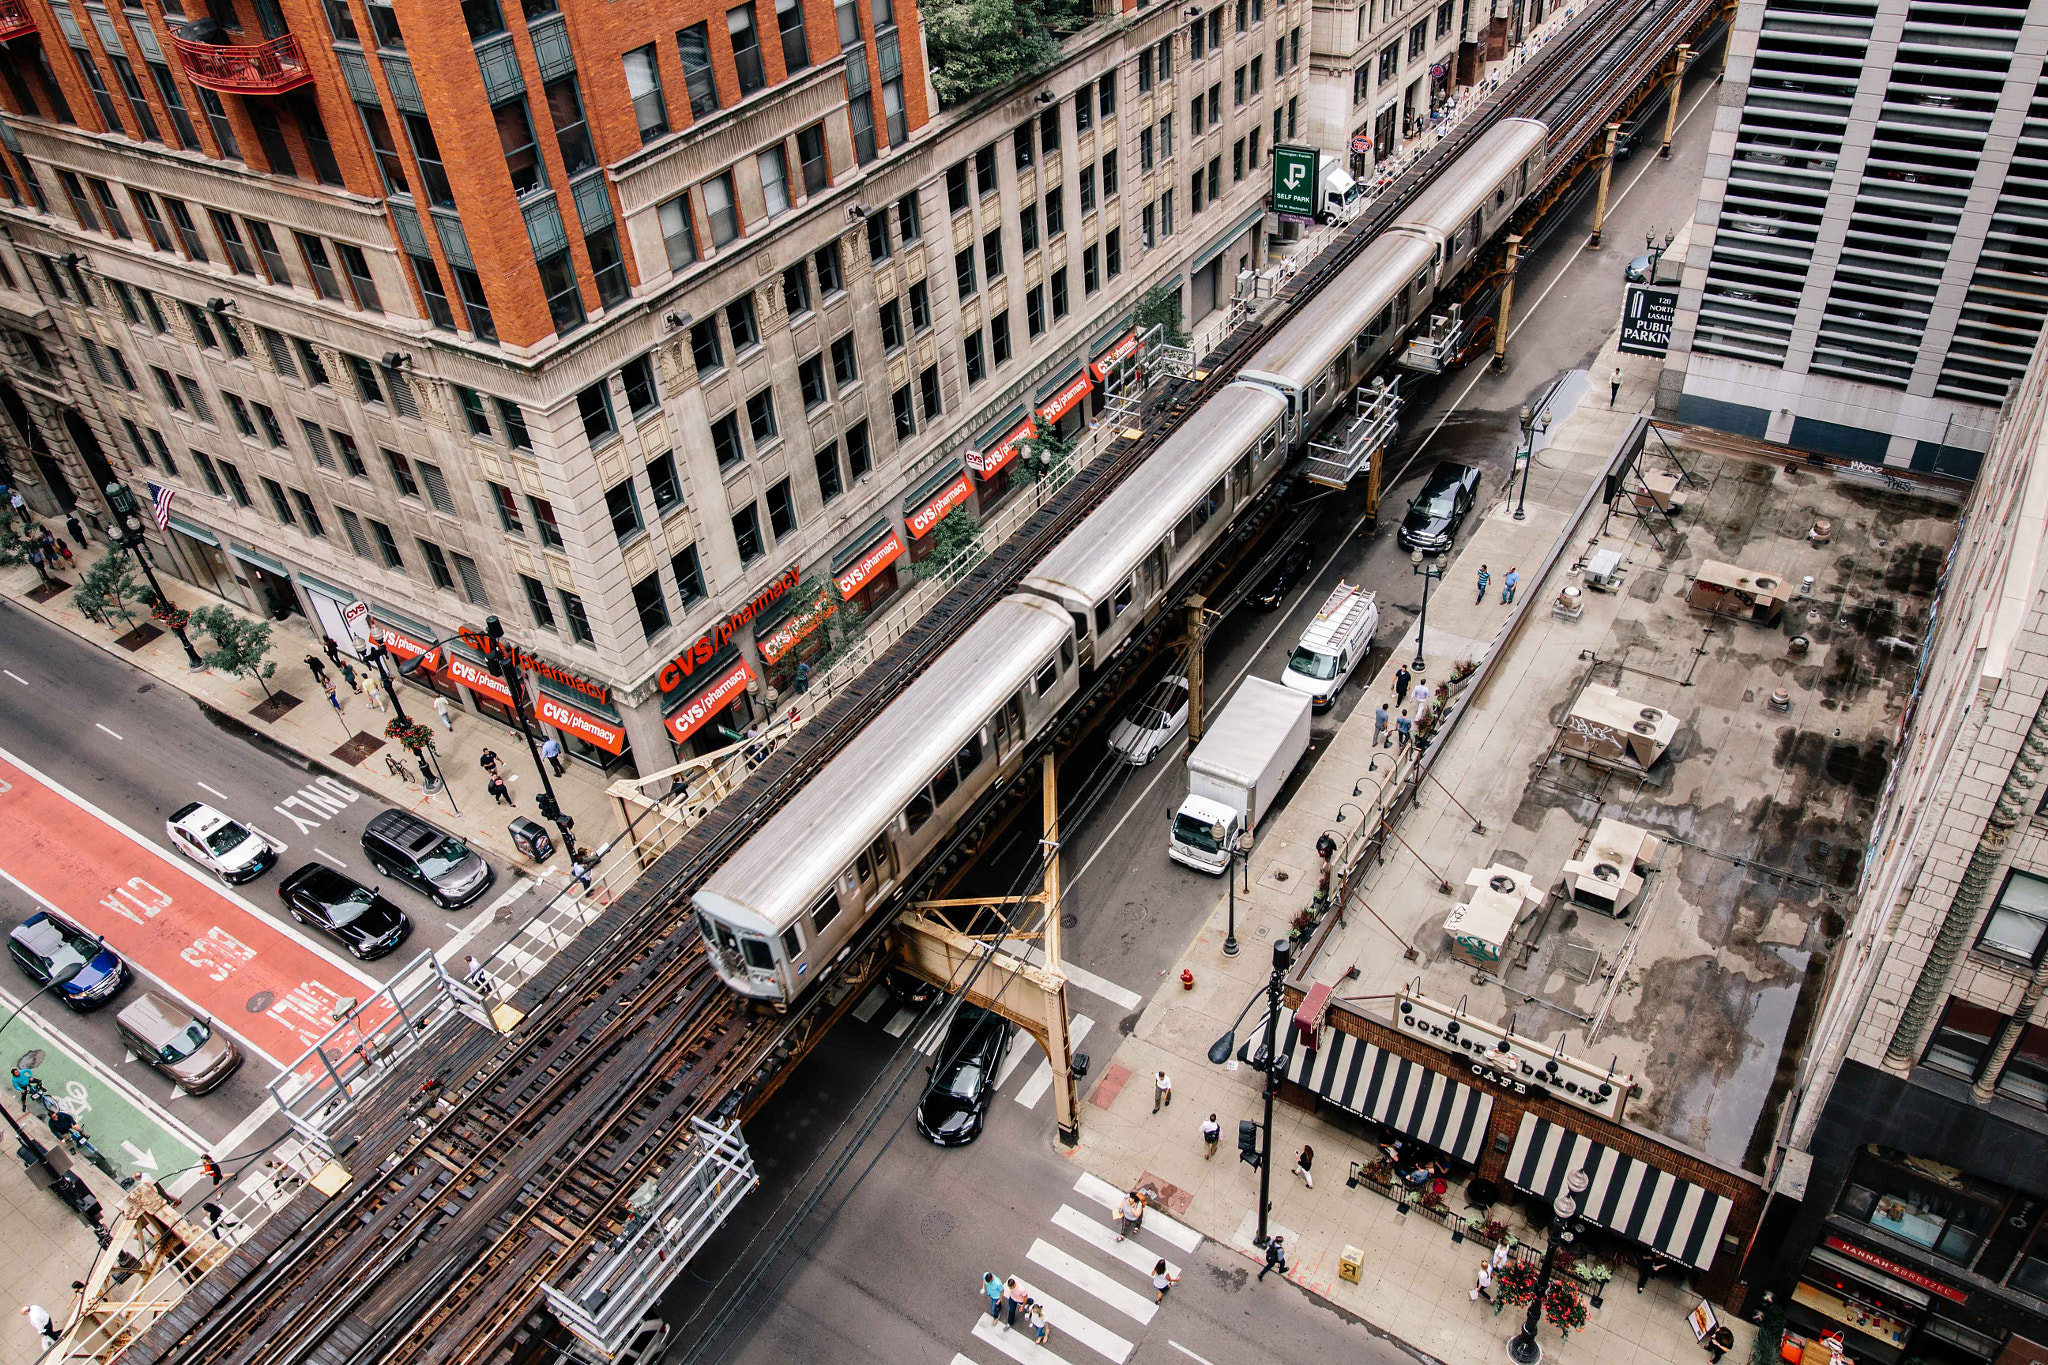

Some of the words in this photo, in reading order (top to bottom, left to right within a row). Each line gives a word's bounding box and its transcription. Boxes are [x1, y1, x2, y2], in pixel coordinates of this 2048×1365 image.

[1277, 192, 1292, 200] SELF
[1293, 195, 1310, 203] PARK
[1649, 304, 1675, 313] NORTH
[1624, 328, 1669, 343] PARKIN
[1043, 378, 1087, 420] CVS/pharmacy
[966, 453, 983, 464] CVS
[914, 481, 967, 530] CVS/pharmacy
[840, 539, 899, 593] CVS/pharmacy
[346, 603, 366, 620] CVS
[659, 565, 800, 693] CVS/pharmacy
[382, 628, 436, 663] VS/pharmacy
[452, 661, 513, 698] CVS/pharma
[458, 626, 606, 705] CV/pharmacy
[675, 667, 747, 732] CVS/pharmacy
[543, 702, 616, 744] CVS/pharmacy
[273, 775, 360, 835] ONLY
[99, 876, 173, 925] CTA
[1403, 1014, 1487, 1054] corner
[1520, 1059, 1608, 1105] bakery
[1471, 1064, 1526, 1095] CAFE
[1578, 1213, 1604, 1228] Sweets
[1842, 1243, 1900, 1273] HANNAH'S
